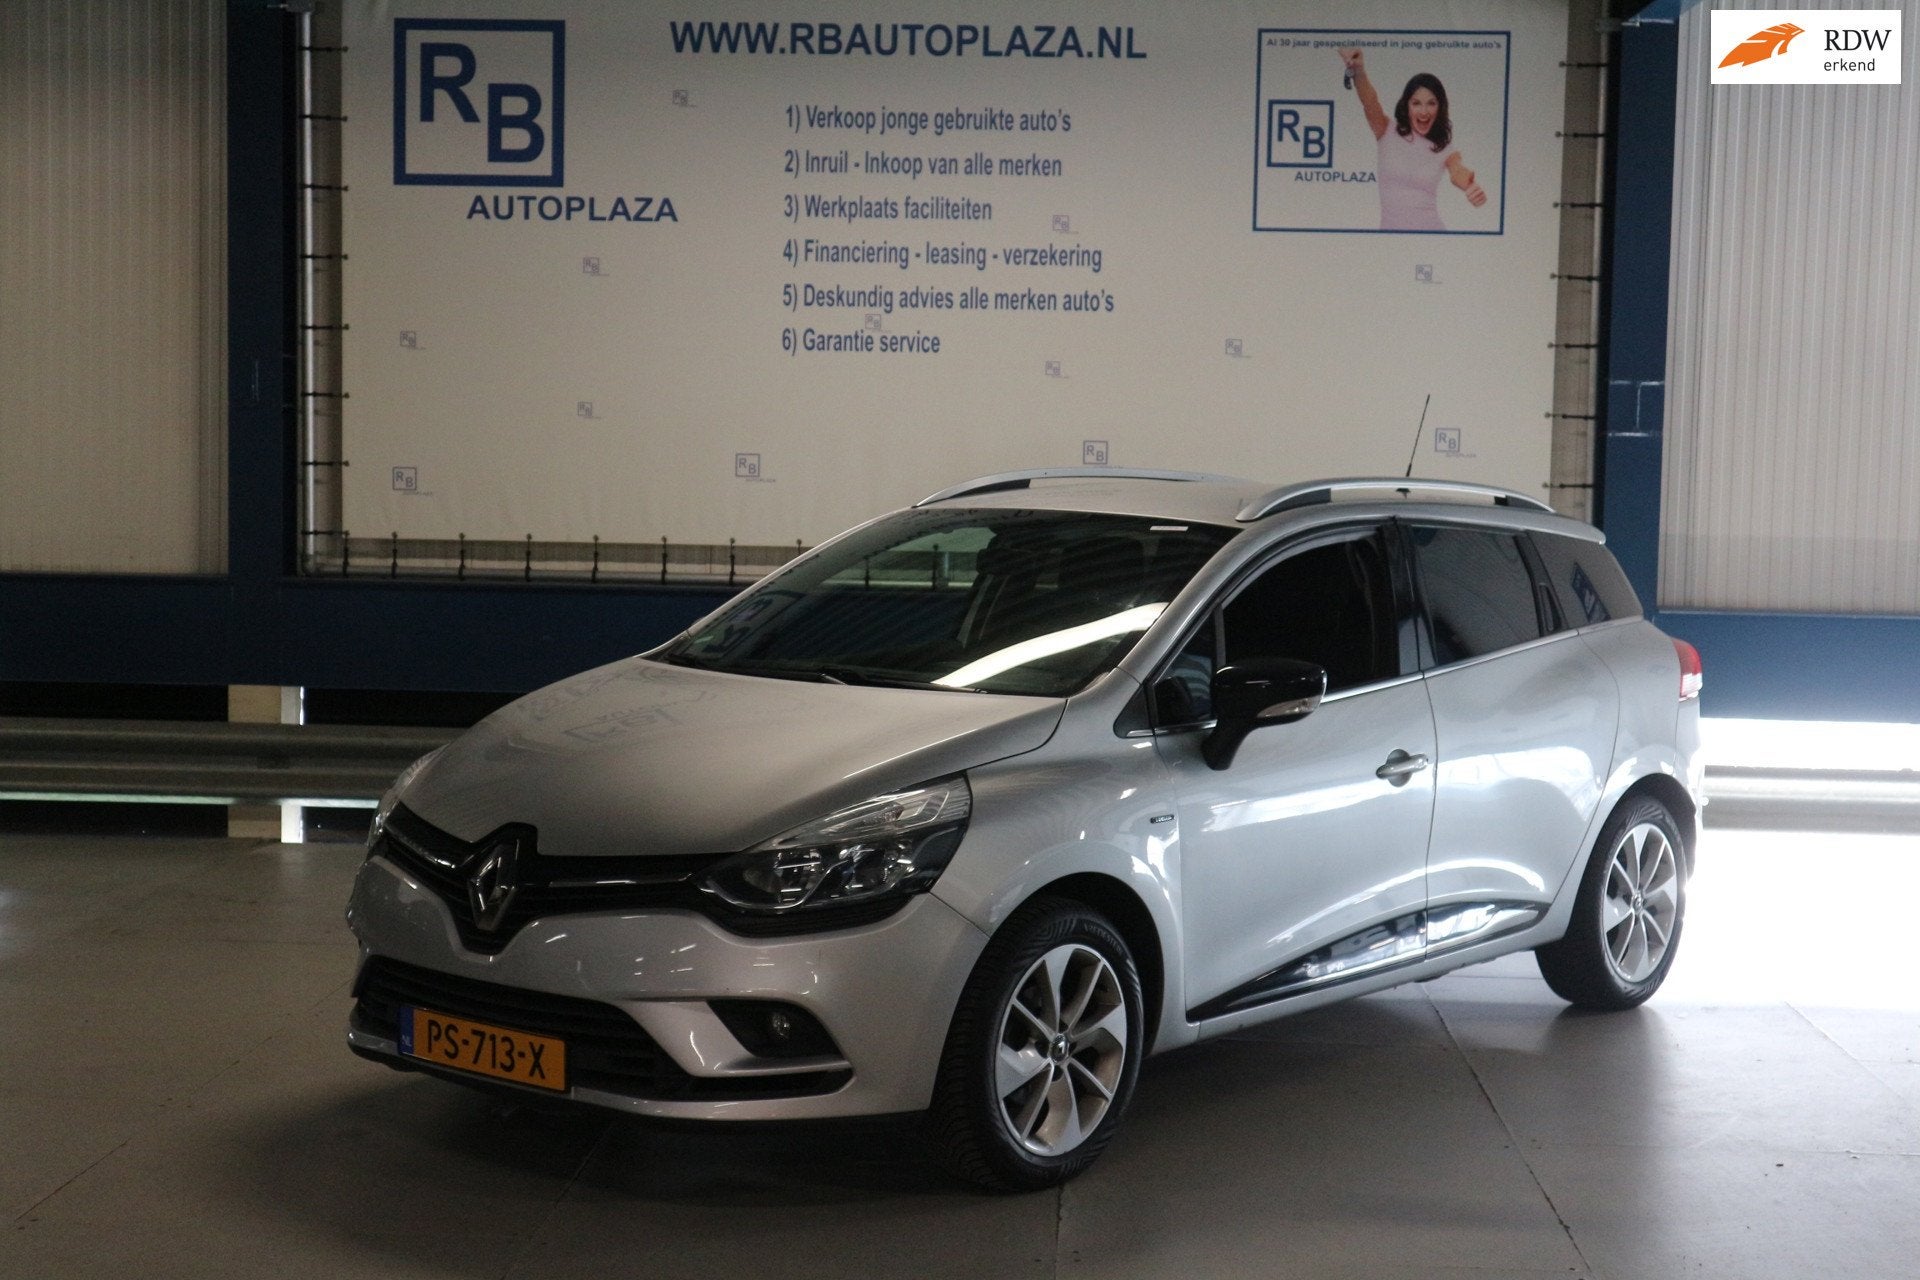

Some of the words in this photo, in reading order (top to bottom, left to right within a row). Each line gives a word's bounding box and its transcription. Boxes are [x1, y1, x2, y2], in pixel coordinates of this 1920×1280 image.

[670, 21, 1147, 59] WWW.RBAUTOPLAZA.NL
[1292, 39, 1310, 48] jaar
[1313, 39, 1388, 48] gespecialiseerd
[1390, 40, 1399, 48] in
[1401, 40, 1422, 49] jong
[1425, 40, 1470, 49] gebruikte
[1472, 40, 1502, 49] auto's
[420, 42, 545, 163] RB
[786, 106, 800, 133] 1)
[805, 106, 876, 134] Verkoop
[880, 107, 928, 135] jonge
[934, 107, 1014, 135] gebruikte
[1020, 109, 1072, 132] auto's
[1277, 109, 1326, 159] RB
[784, 149, 800, 178] 2)
[805, 150, 848, 173] Inruil
[864, 151, 923, 179] Inkoop
[929, 157, 958, 176] van
[964, 152, 993, 176] alle
[999, 153, 1062, 177] merken
[1294, 171, 1377, 183] AUTOPLAZA
[466, 195, 678, 222] AUTOPLAZA
[784, 194, 799, 223] 3)
[804, 195, 898, 223] Werkplaats
[904, 196, 992, 220] faciliteiten
[783, 239, 798, 267] 4)
[804, 239, 909, 270] Financiering
[926, 241, 986, 271] leasing
[1003, 243, 1102, 273] verzekering
[783, 284, 798, 311] 5)
[803, 284, 894, 314] Deskundig
[899, 286, 953, 309] advies
[959, 287, 988, 310] alle
[994, 287, 1057, 311] merken
[1063, 289, 1114, 312] auto's
[782, 328, 797, 356] 6)
[803, 328, 874, 352] Garantie
[880, 330, 940, 353] service
[402, 1035, 412, 1047] NL
[427, 1019, 546, 1080] PS-713-X
